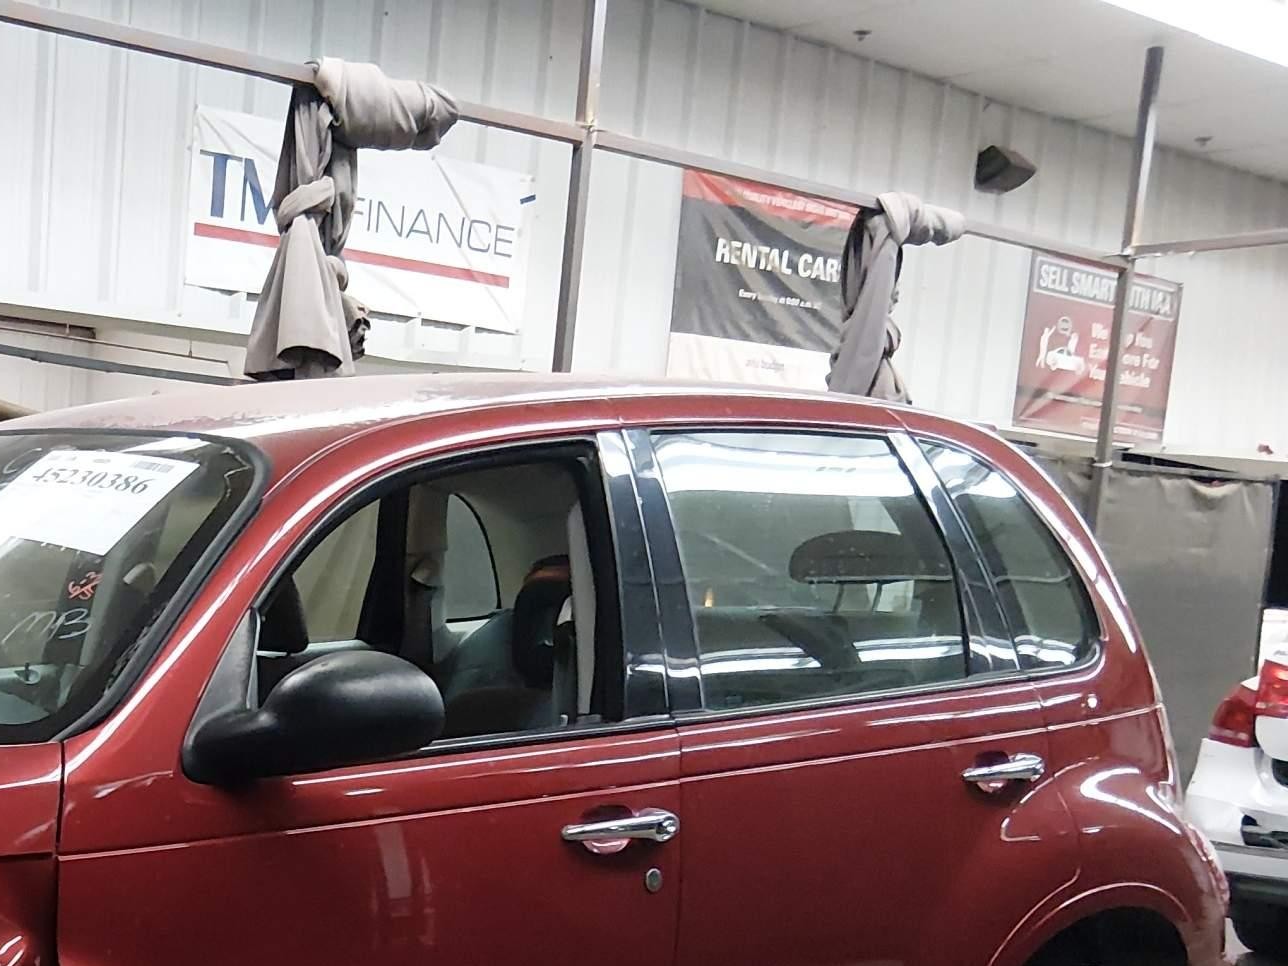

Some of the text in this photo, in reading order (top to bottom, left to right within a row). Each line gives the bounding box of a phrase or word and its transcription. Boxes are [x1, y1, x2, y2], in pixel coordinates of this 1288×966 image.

[715, 238, 792, 275] RENTAL
[1039, 264, 1069, 292] SELL
[1070, 272, 1118, 302] SMART
[1129, 285, 1151, 310] ITH
